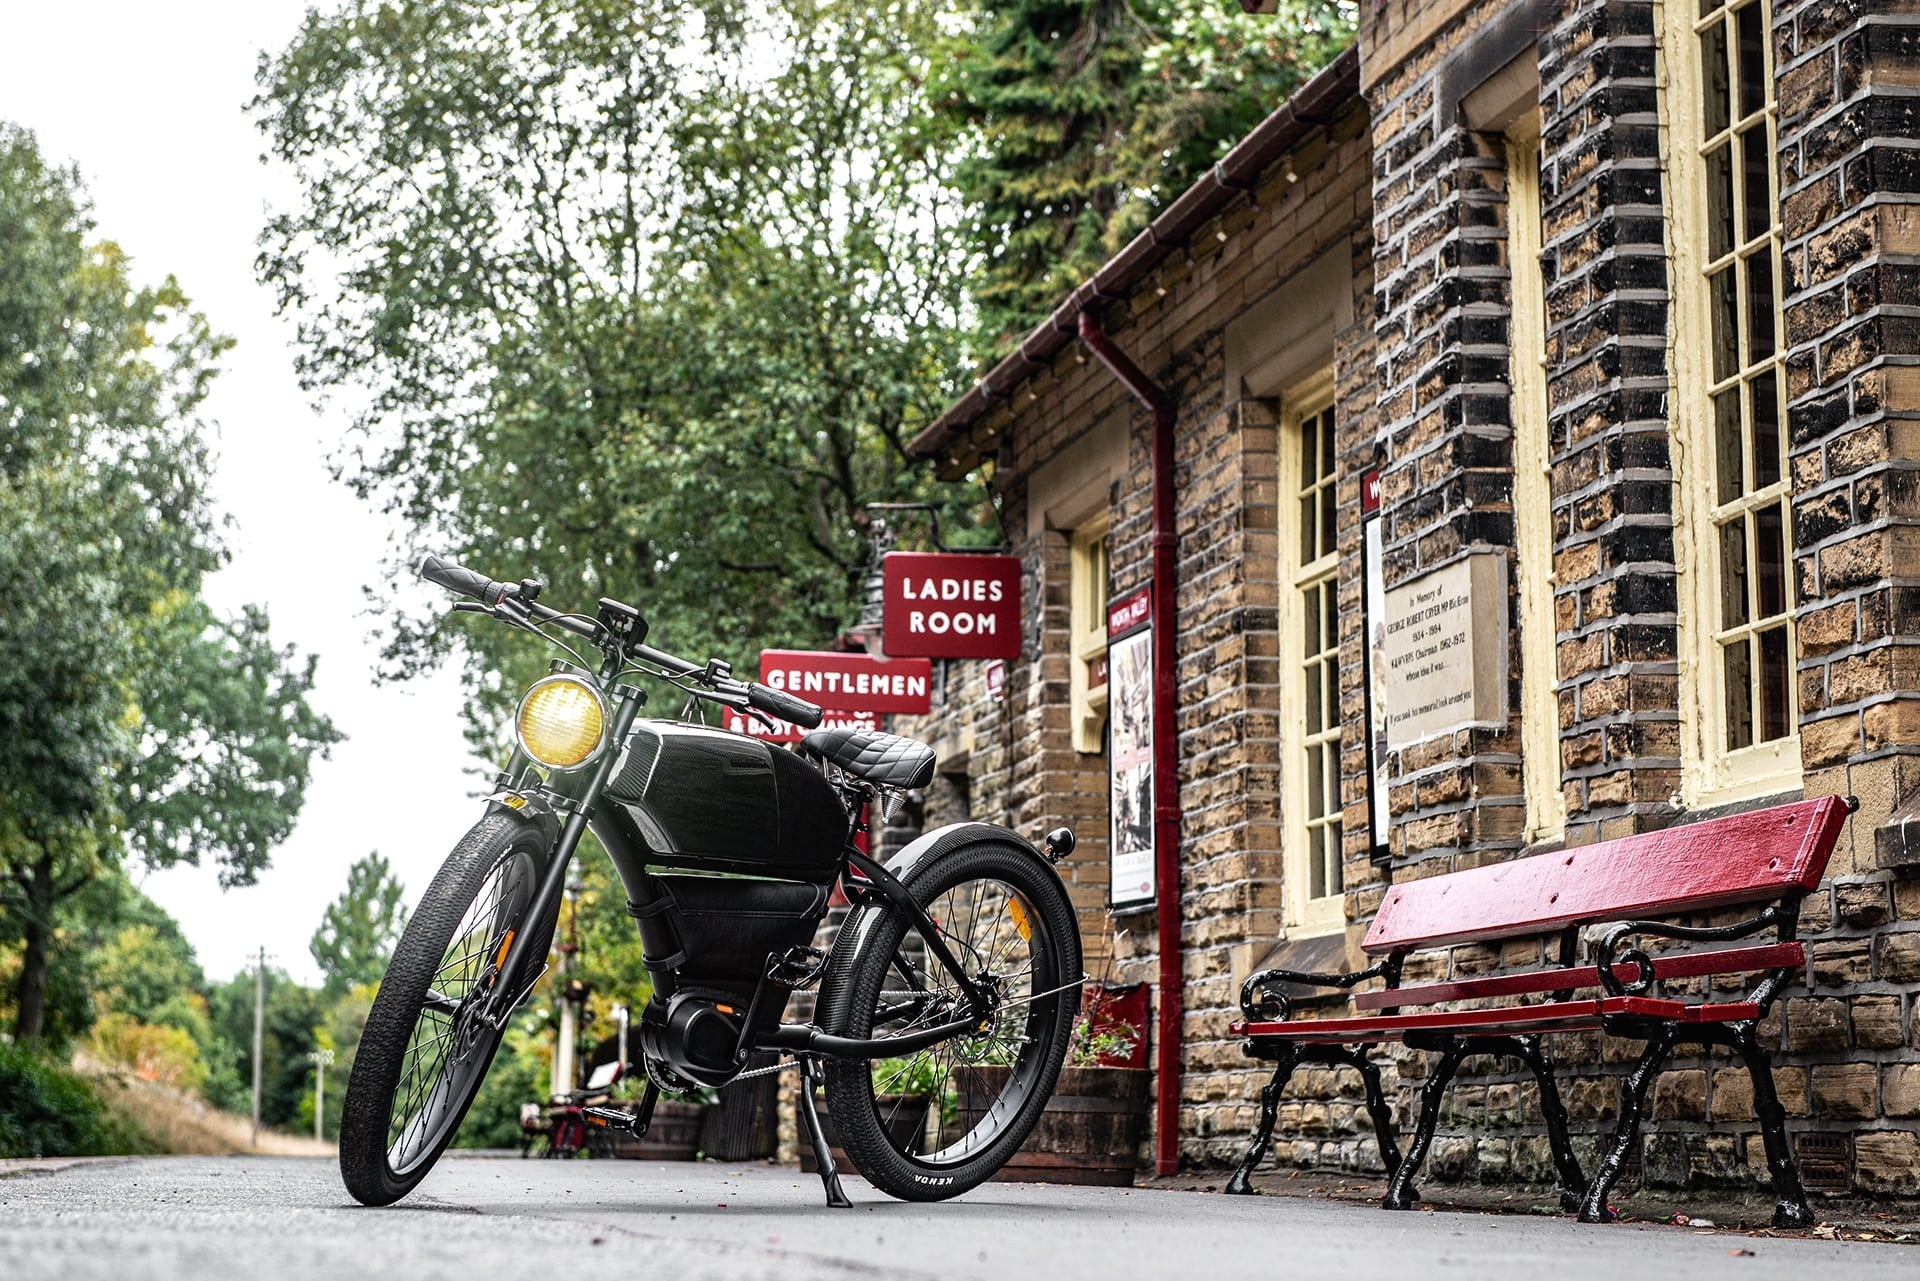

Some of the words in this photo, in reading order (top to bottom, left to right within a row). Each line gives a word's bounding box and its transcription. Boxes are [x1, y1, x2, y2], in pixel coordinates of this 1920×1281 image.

[903, 577, 1003, 602] LADIES
[1416, 590, 1436, 605] Memory
[1436, 584, 1443, 596] of
[909, 610, 997, 635] ROOM
[1386, 618, 1405, 635] GEORGE
[1406, 610, 1425, 628] ROBERT
[1424, 604, 1440, 620] CRYER
[1412, 629, 1425, 643] 1934
[1428, 623, 1442, 637] 1994
[1415, 645, 1438, 660] Chairman
[766, 669, 926, 697] GENTLEMEN
[730, 716, 744, 734] &
[914, 1174, 954, 1186] KENDA
